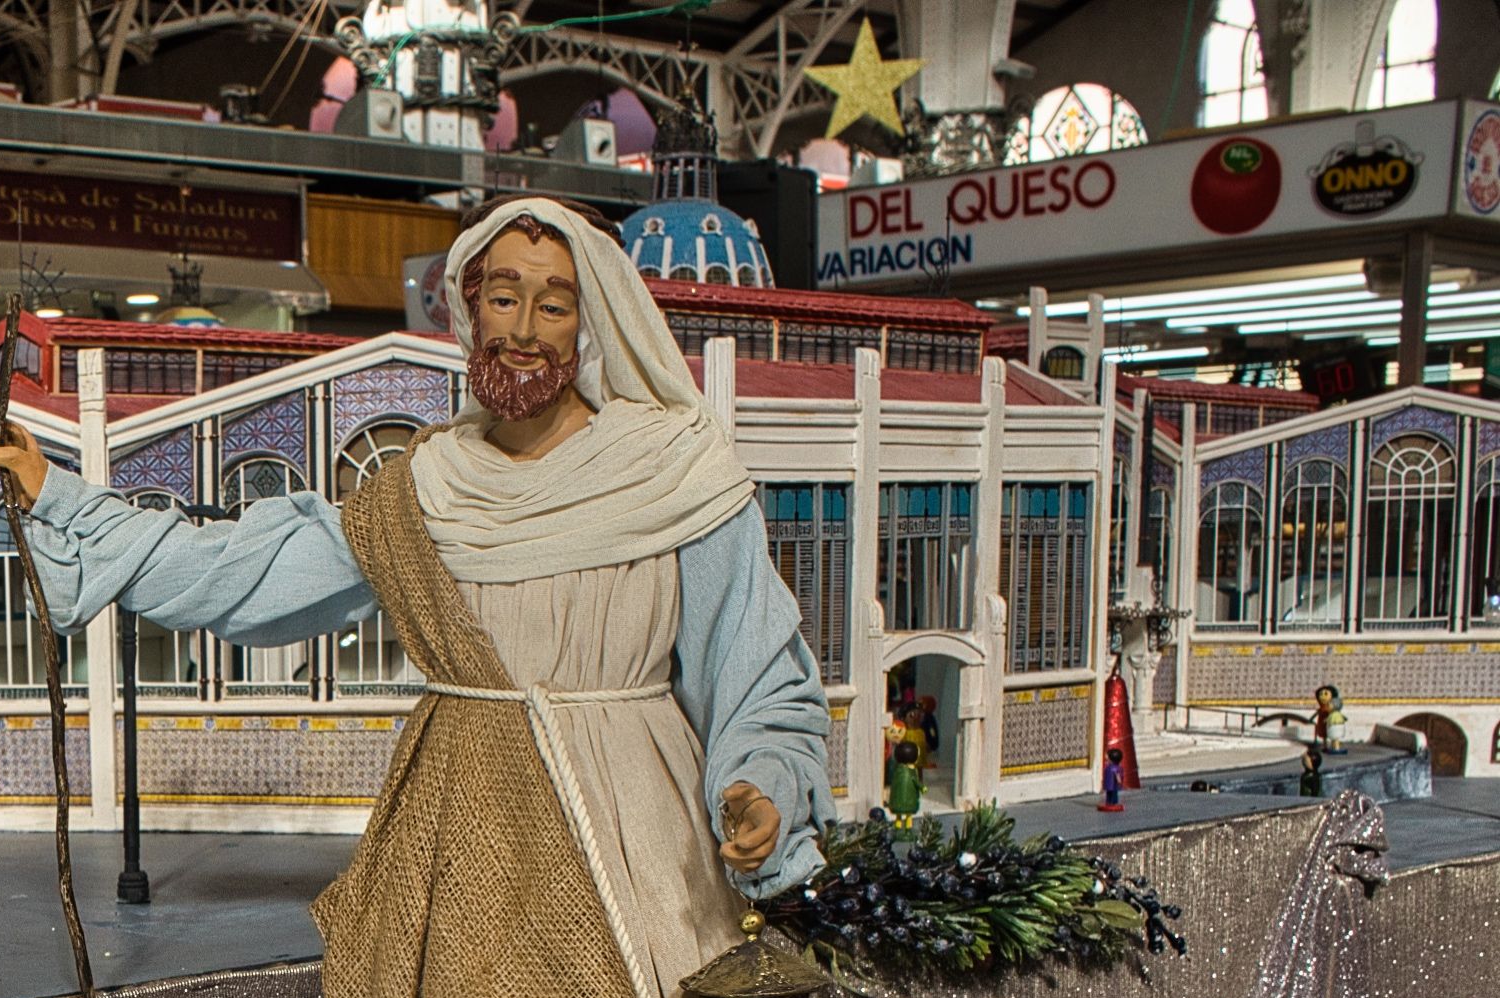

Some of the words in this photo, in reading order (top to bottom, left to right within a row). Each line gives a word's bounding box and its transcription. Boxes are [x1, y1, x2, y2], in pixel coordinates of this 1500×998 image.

[1322, 159, 1407, 194] ONNO
[80, 187, 119, 209] de
[849, 188, 924, 239] DEL
[948, 159, 1116, 226] QUESO
